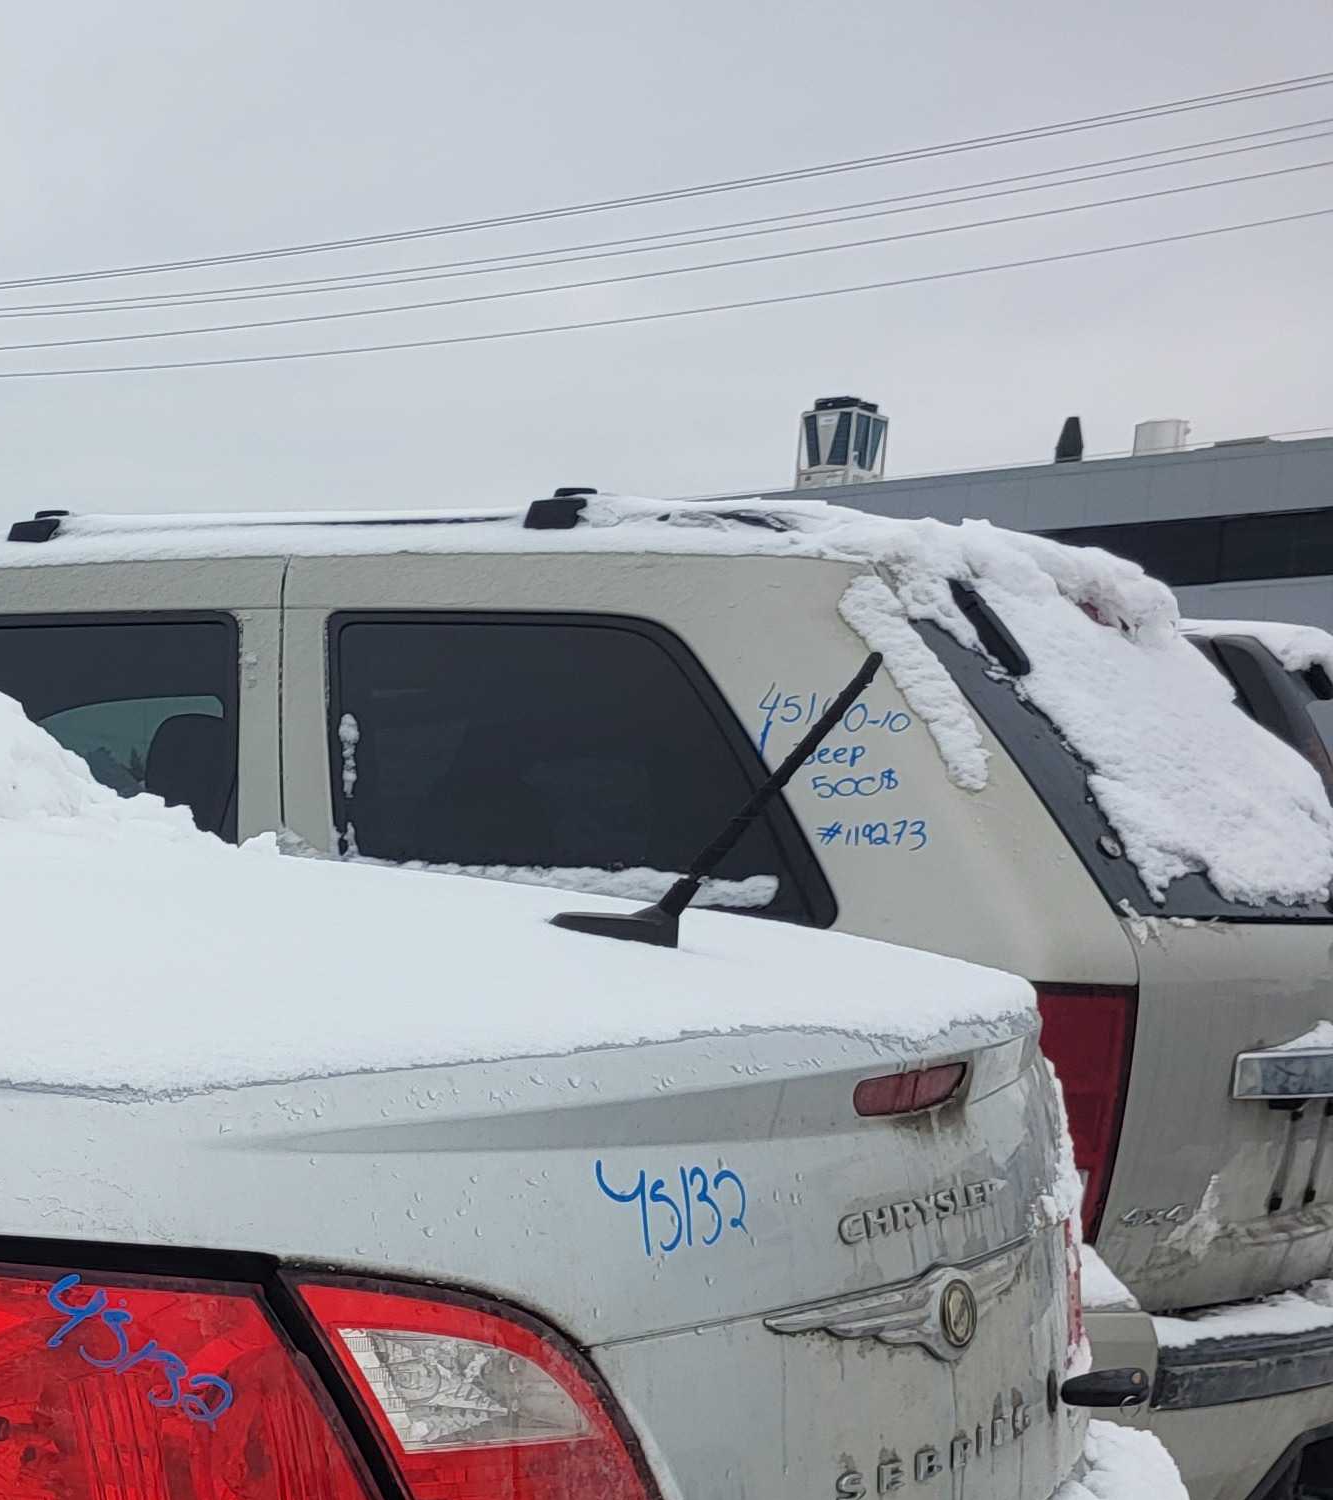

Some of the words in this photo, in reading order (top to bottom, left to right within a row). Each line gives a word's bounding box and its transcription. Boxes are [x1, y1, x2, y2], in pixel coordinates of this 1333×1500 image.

[758, 682, 911, 742] 4510-10
[816, 819, 927, 851] #119273
[595, 1159, 749, 1256] 45132
[838, 1178, 1007, 1246] CHRYSLER
[46, 1273, 233, 1432] 45132
